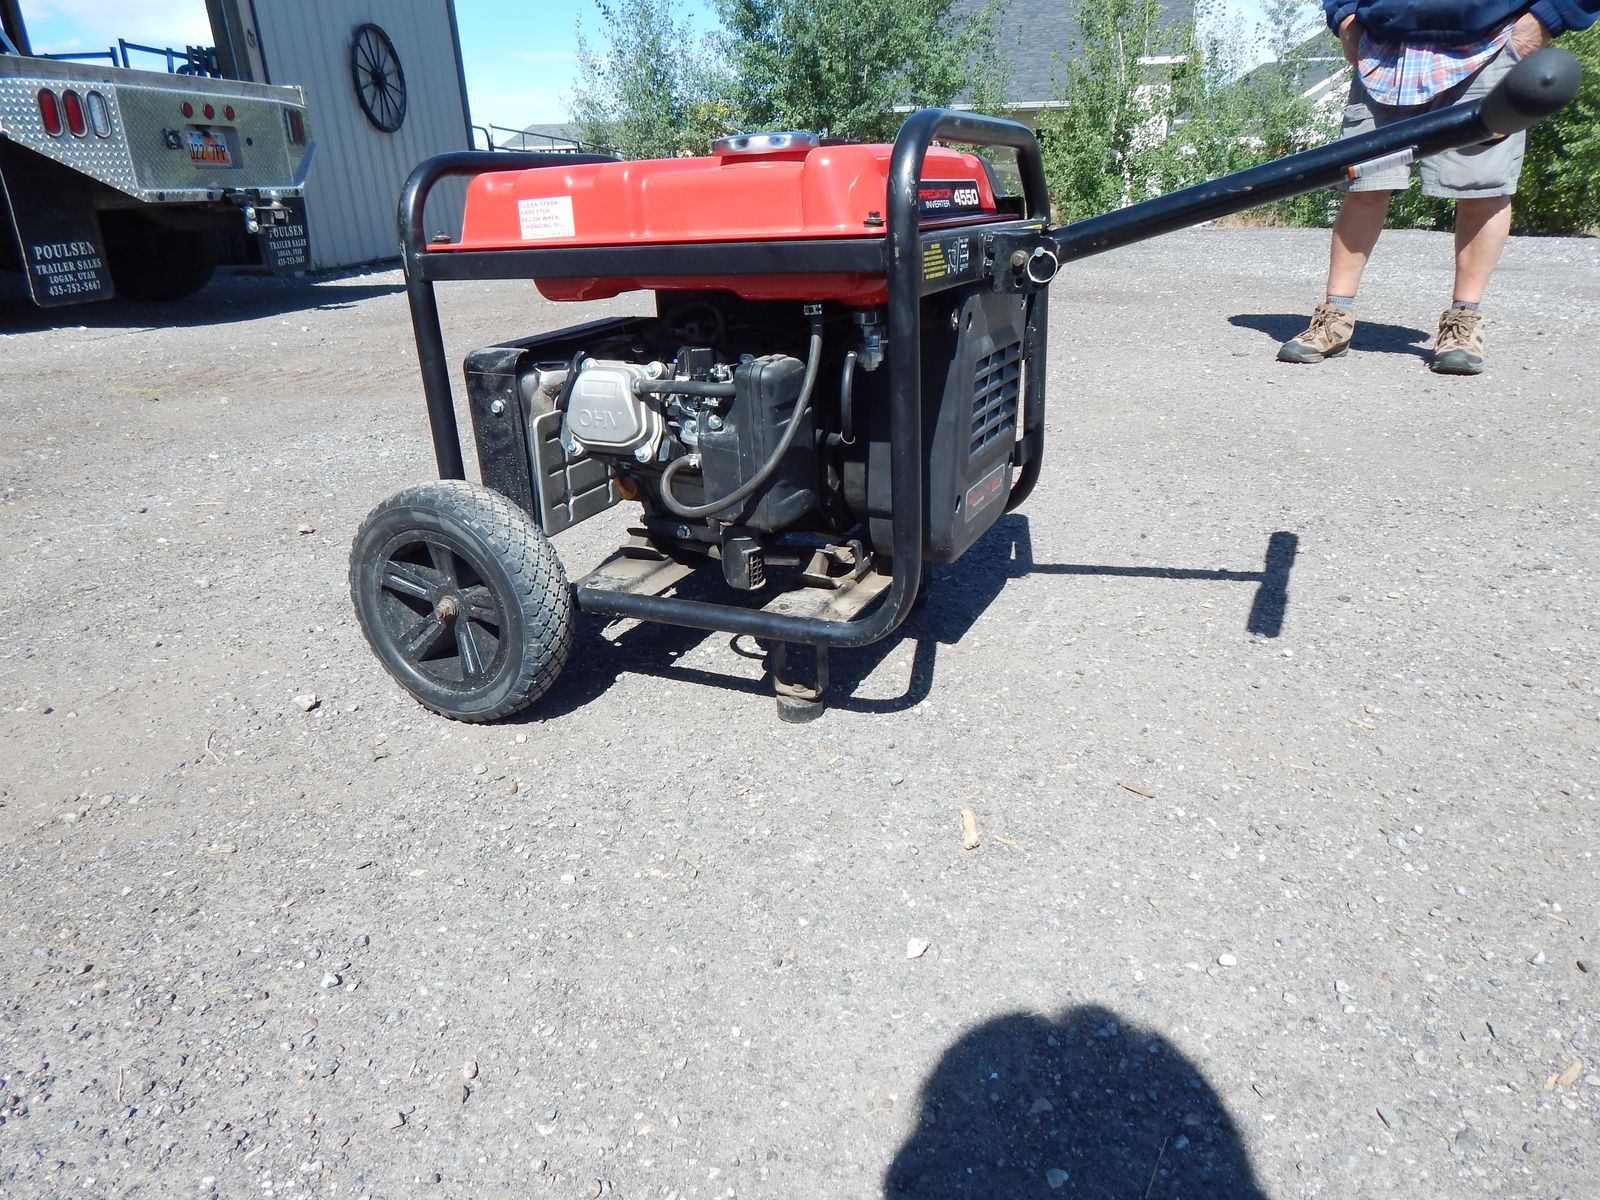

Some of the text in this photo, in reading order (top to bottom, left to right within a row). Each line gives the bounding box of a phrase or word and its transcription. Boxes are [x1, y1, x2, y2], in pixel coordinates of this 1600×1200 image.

[925, 200, 951, 208] INVERTER
[954, 189, 979, 205] 4550
[34, 241, 96, 260] POULSEN
[269, 238, 306, 250] TRAILER SALES
[36, 258, 102, 275] TRAILER SALES
[49, 271, 97, 284] LOGAN, UTAH
[49, 280, 101, 296] 435-752-5667
[579, 408, 622, 430] OHV
